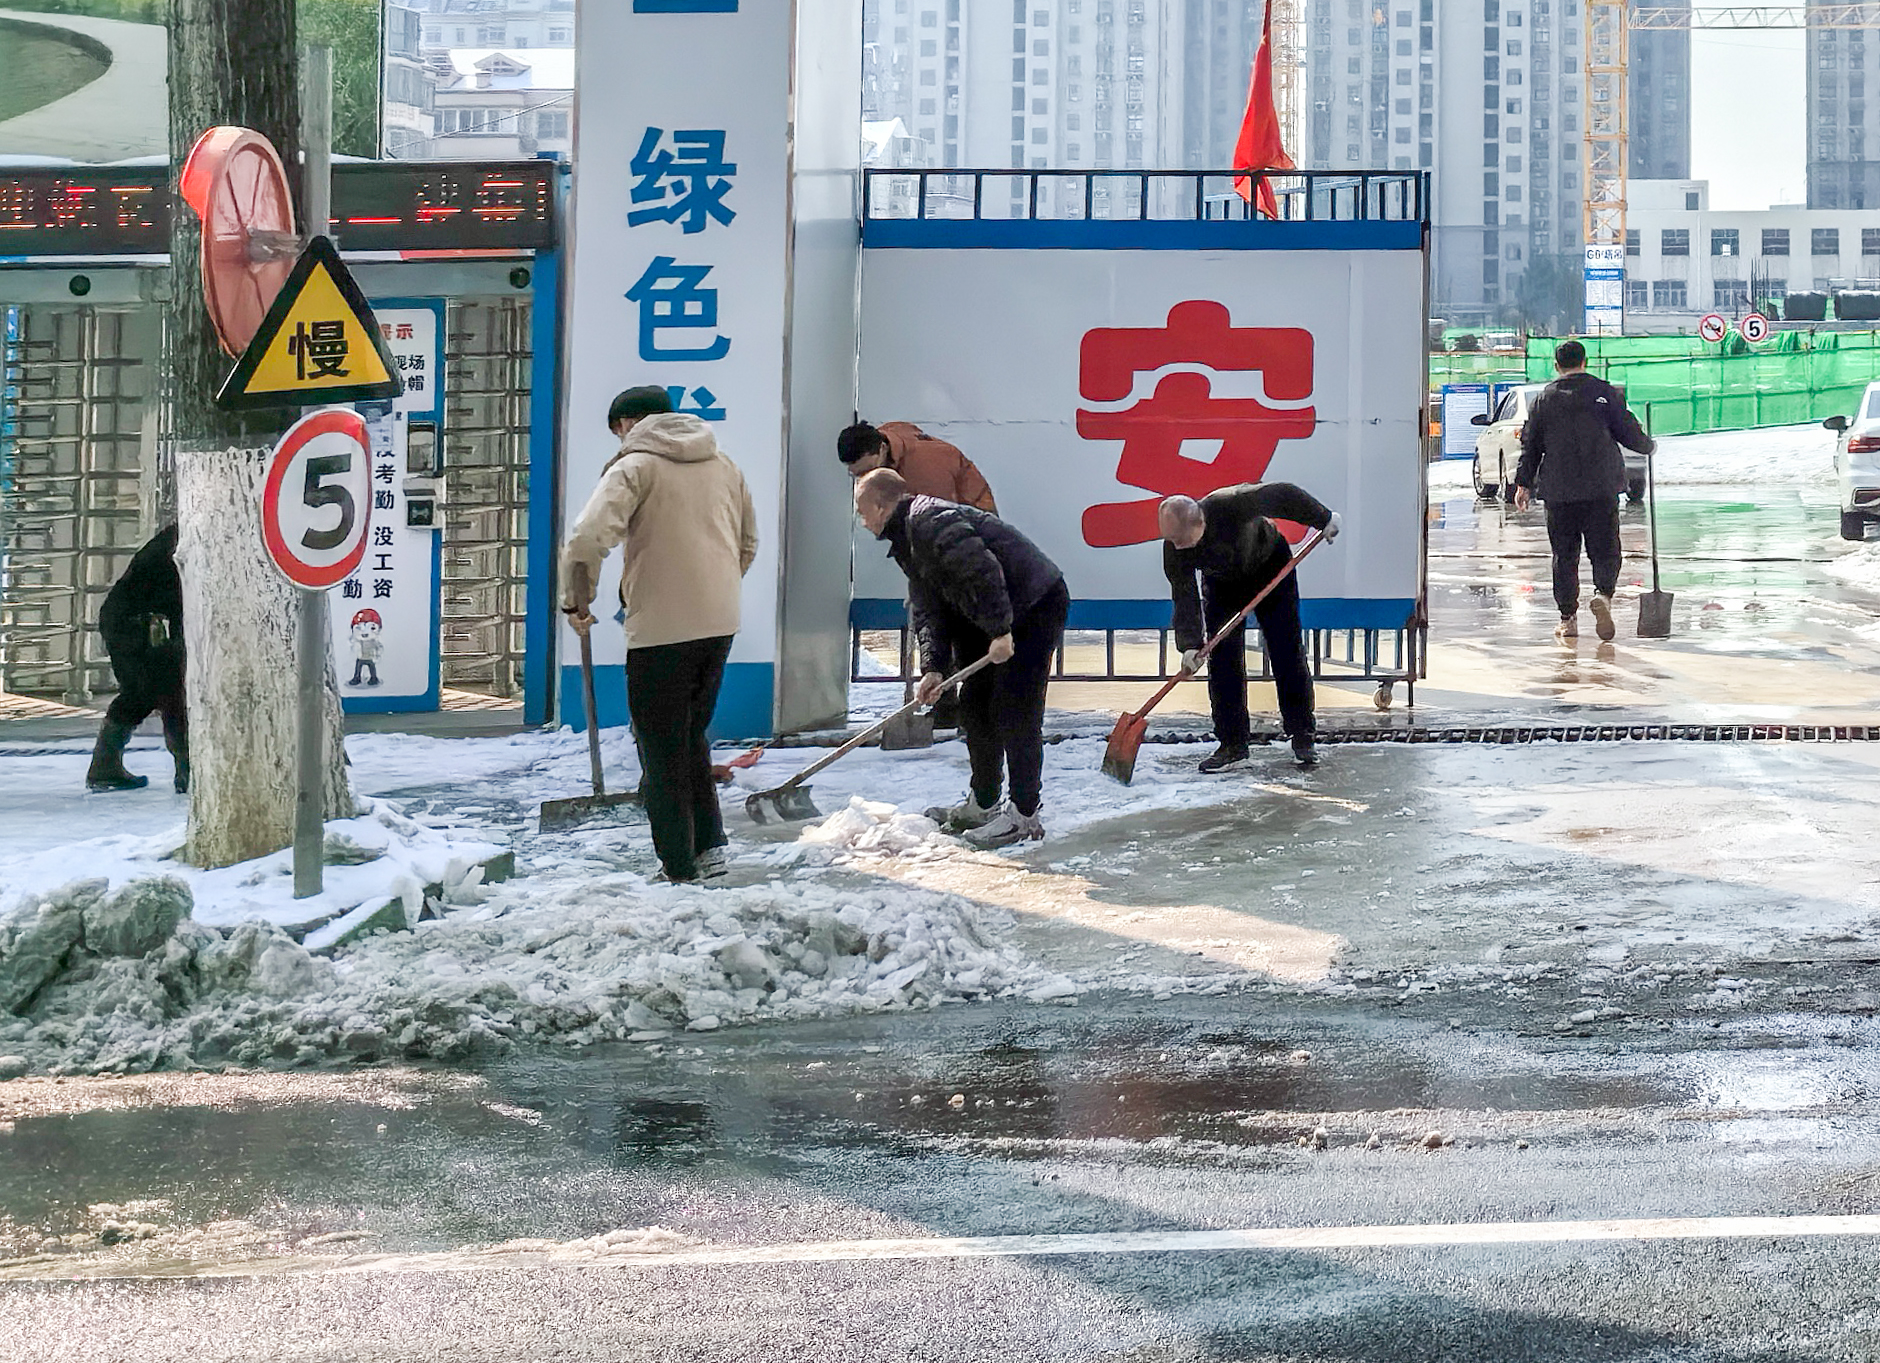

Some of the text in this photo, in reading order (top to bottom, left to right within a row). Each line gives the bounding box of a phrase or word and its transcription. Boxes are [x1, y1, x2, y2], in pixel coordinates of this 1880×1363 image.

[624, 127, 737, 421] 绿色
[289, 320, 350, 381] 慢
[1749, 320, 1761, 337] 5
[1077, 300, 1316, 547] 安
[301, 453, 355, 551] 5
[372, 526, 394, 598] 没工资
